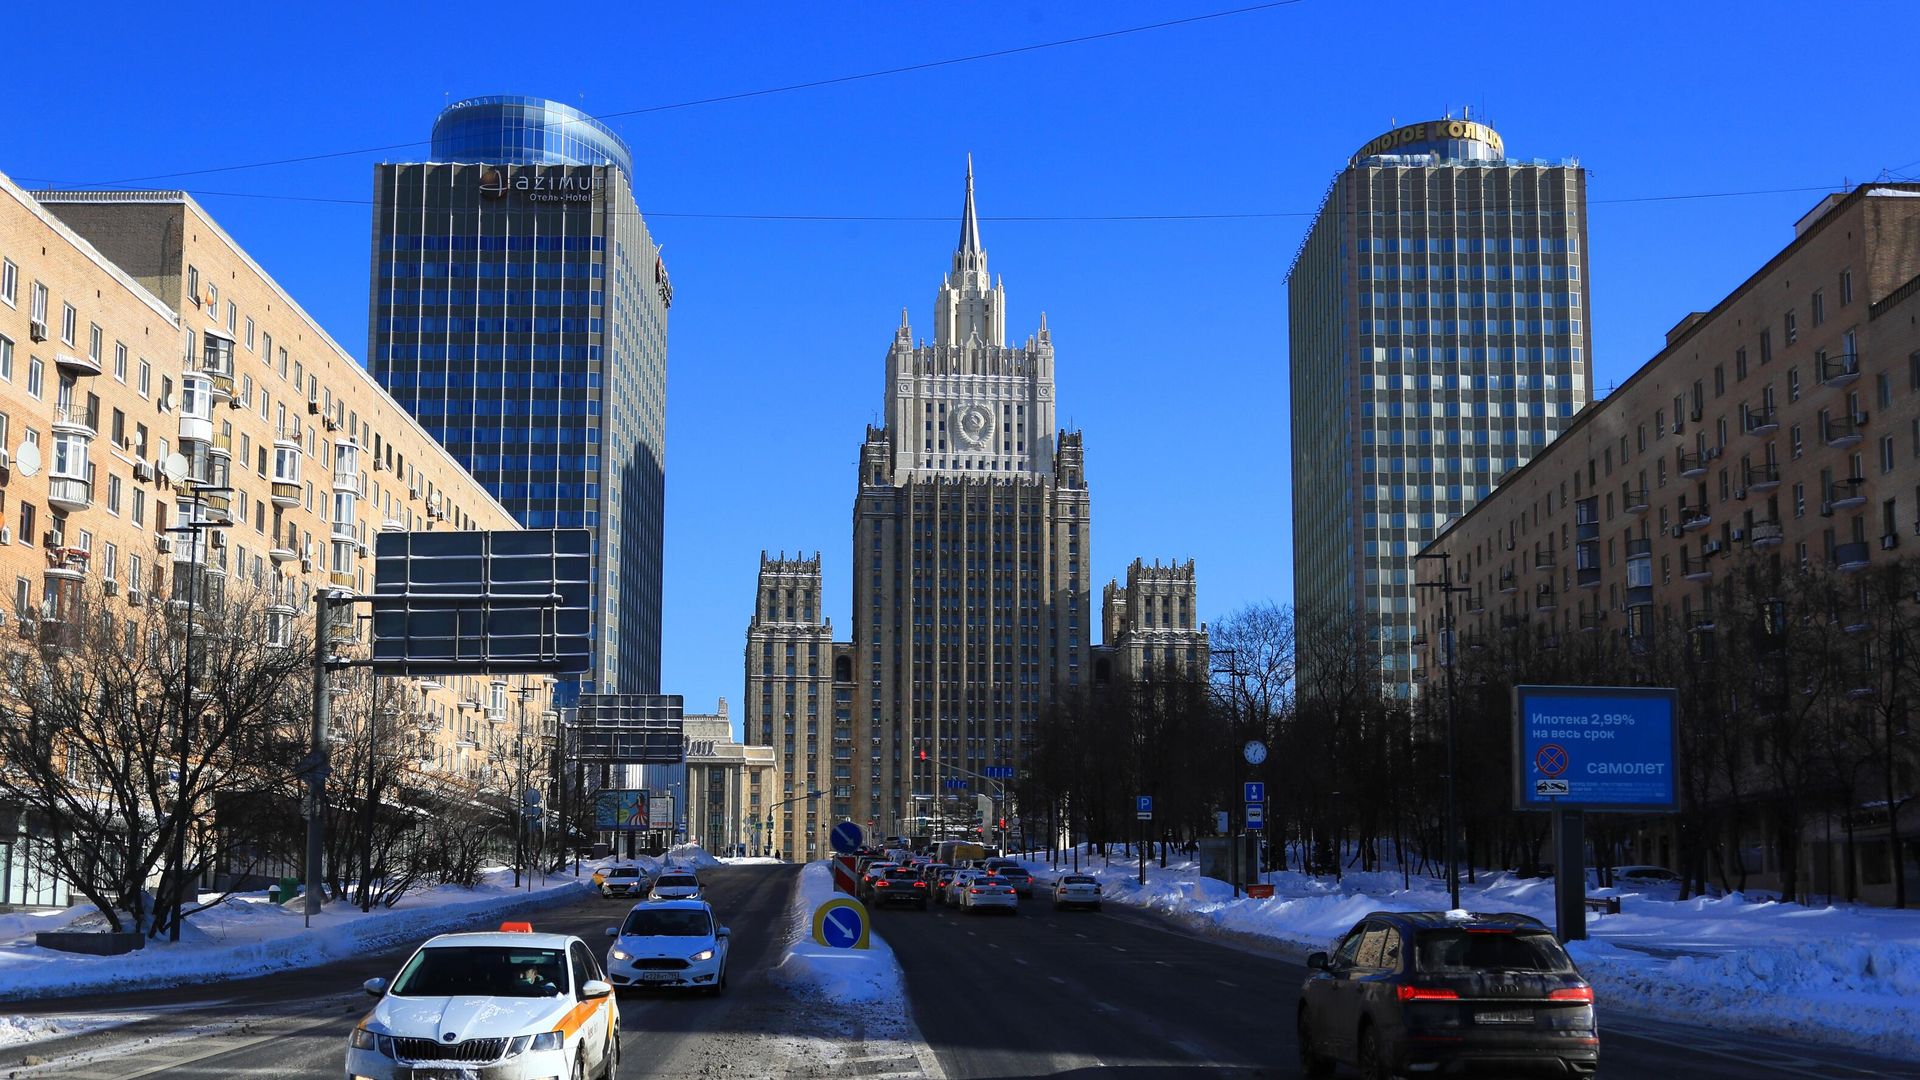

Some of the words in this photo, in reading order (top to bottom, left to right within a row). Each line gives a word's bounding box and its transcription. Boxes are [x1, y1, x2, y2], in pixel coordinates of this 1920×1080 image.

[530, 193, 558, 201] Отель
[566, 193, 591, 201] Hotel
[1532, 713, 1588, 725] Ипотека
[1591, 713, 1635, 726] 2,99%
[1532, 729, 1548, 738] на
[1551, 729, 1580, 738] весь
[1584, 730, 1615, 741] срок
[1587, 763, 1664, 774] самолет
[1141, 798, 1149, 809] P
